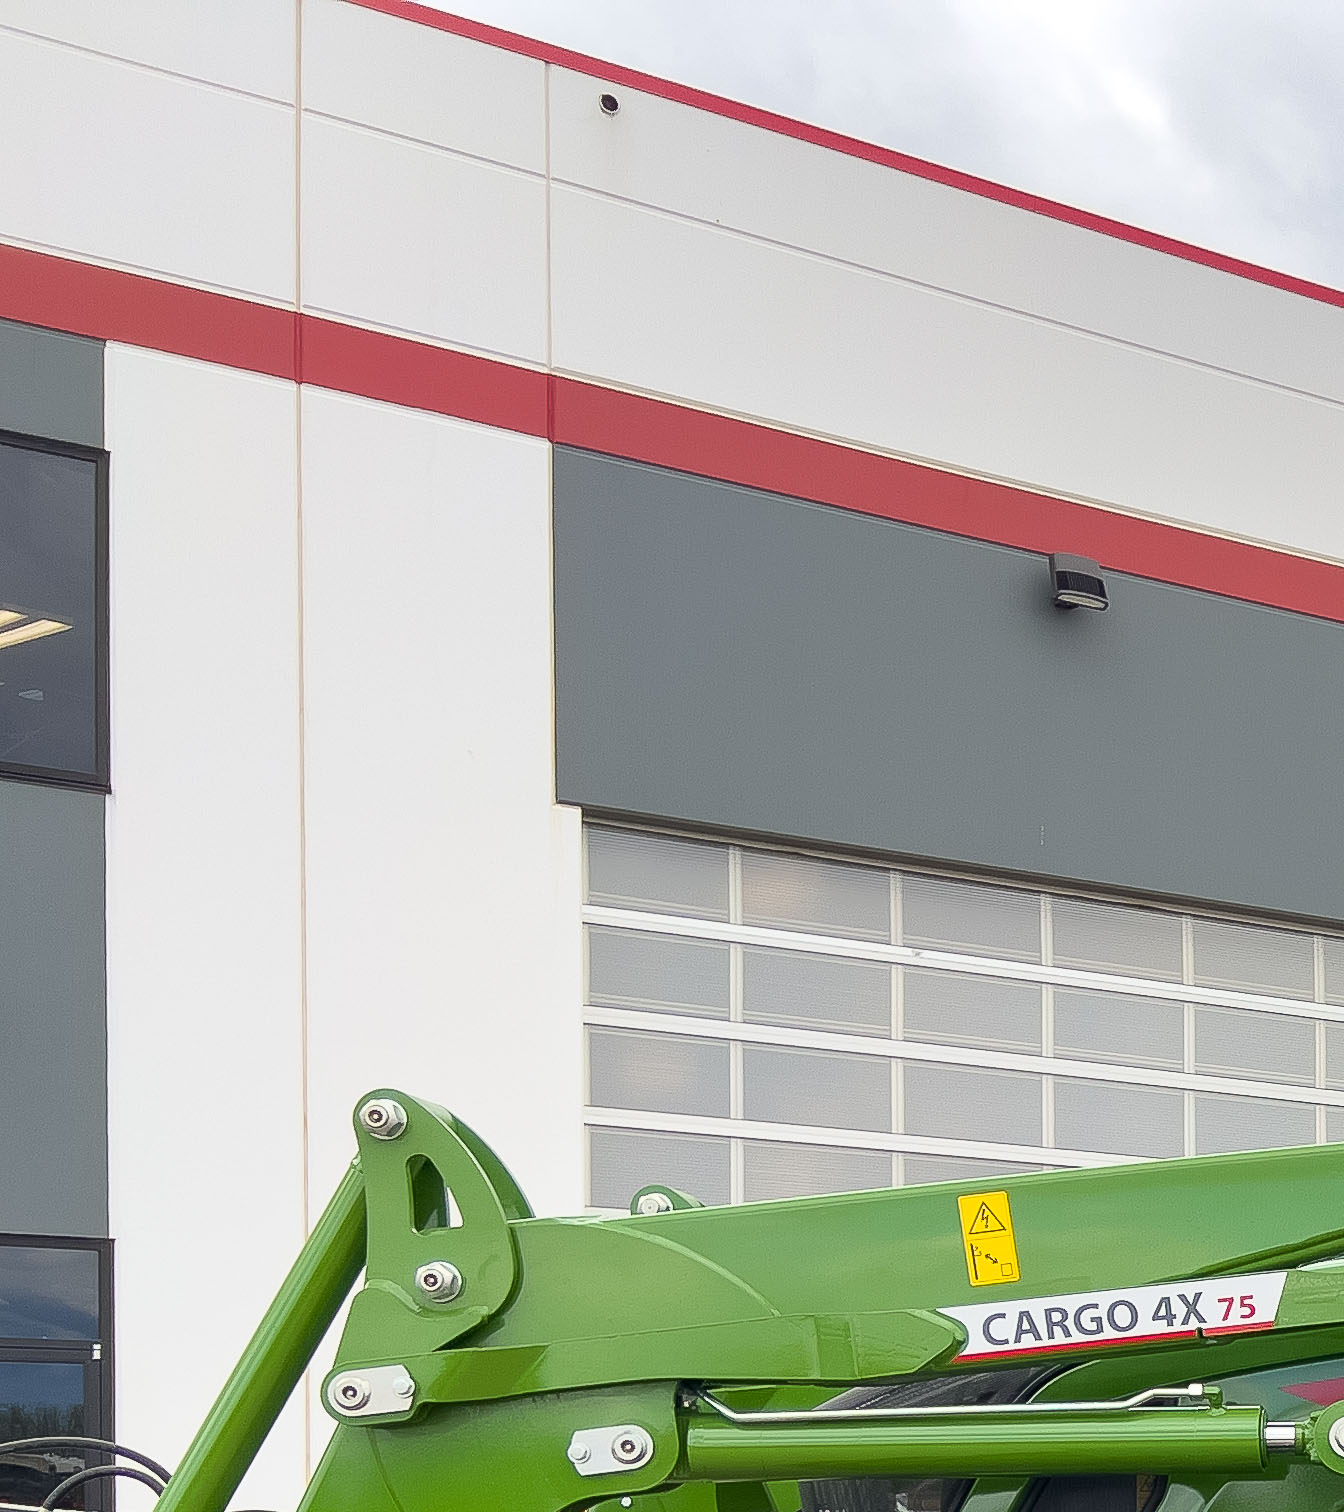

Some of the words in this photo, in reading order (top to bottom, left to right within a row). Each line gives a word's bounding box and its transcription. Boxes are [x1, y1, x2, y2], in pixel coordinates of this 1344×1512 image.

[982, 1299, 1104, 1346] CARGO
[1151, 1291, 1207, 1328] 4X
[1217, 1295, 1256, 1322] 75
